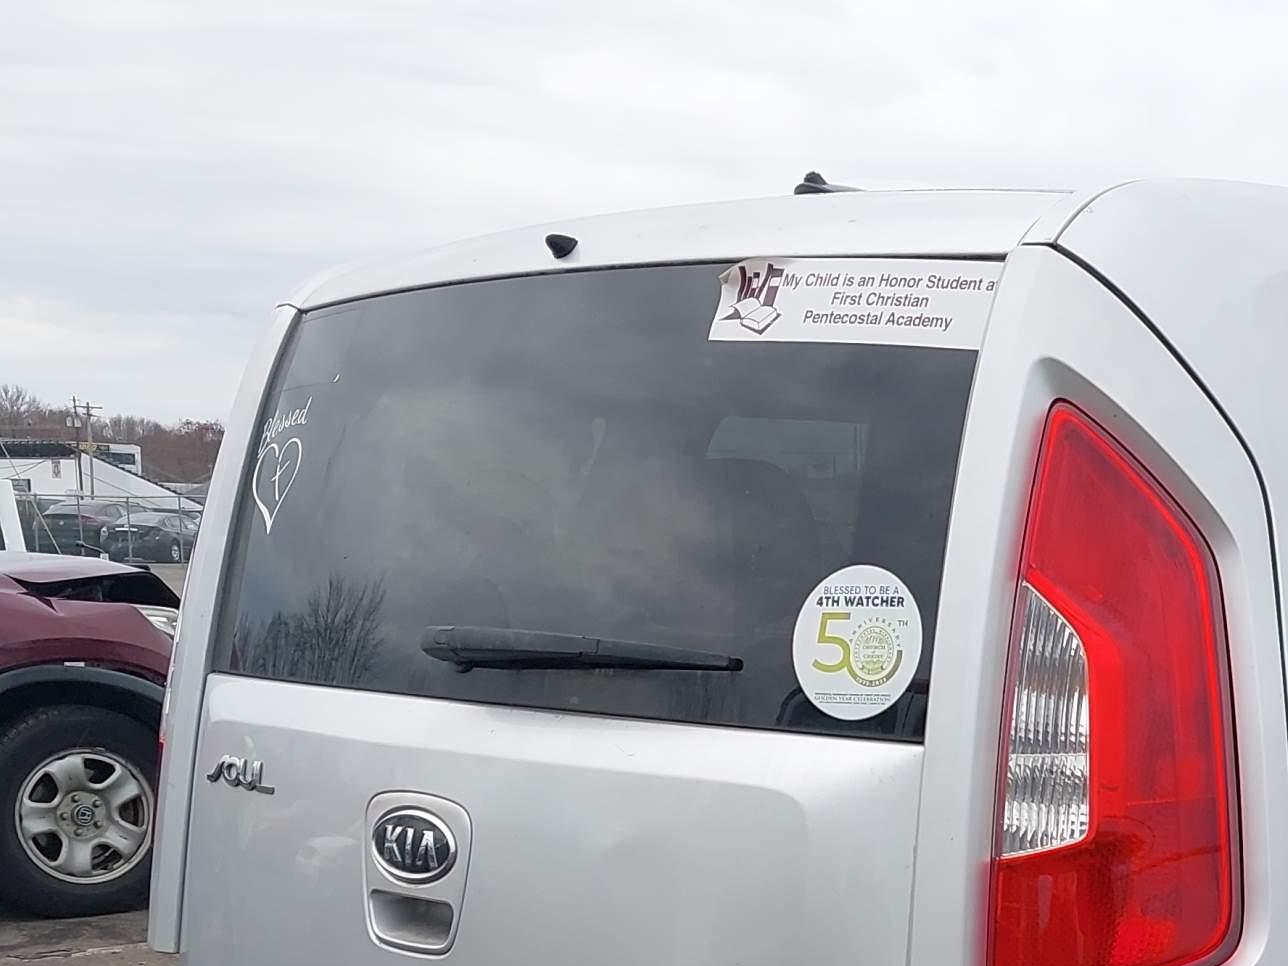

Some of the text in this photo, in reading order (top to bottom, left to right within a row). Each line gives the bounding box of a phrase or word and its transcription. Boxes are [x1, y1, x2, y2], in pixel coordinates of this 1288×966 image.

[783, 273, 802, 290] My
[805, 273, 840, 288] Child
[843, 273, 855, 288] is
[858, 276, 875, 288] an
[878, 273, 923, 289] Honor
[926, 275, 983, 291] Student
[831, 292, 929, 308] First Christian
[803, 310, 953, 332] Pentecostal Academy
[257, 396, 313, 459] Blessed
[824, 585, 900, 595] BLESSED TO BE A
[816, 596, 905, 608] 4TH WATCHER
[898, 619, 909, 628] TH
[206, 754, 275, 796] SOUL
[383, 824, 439, 869] KIA
